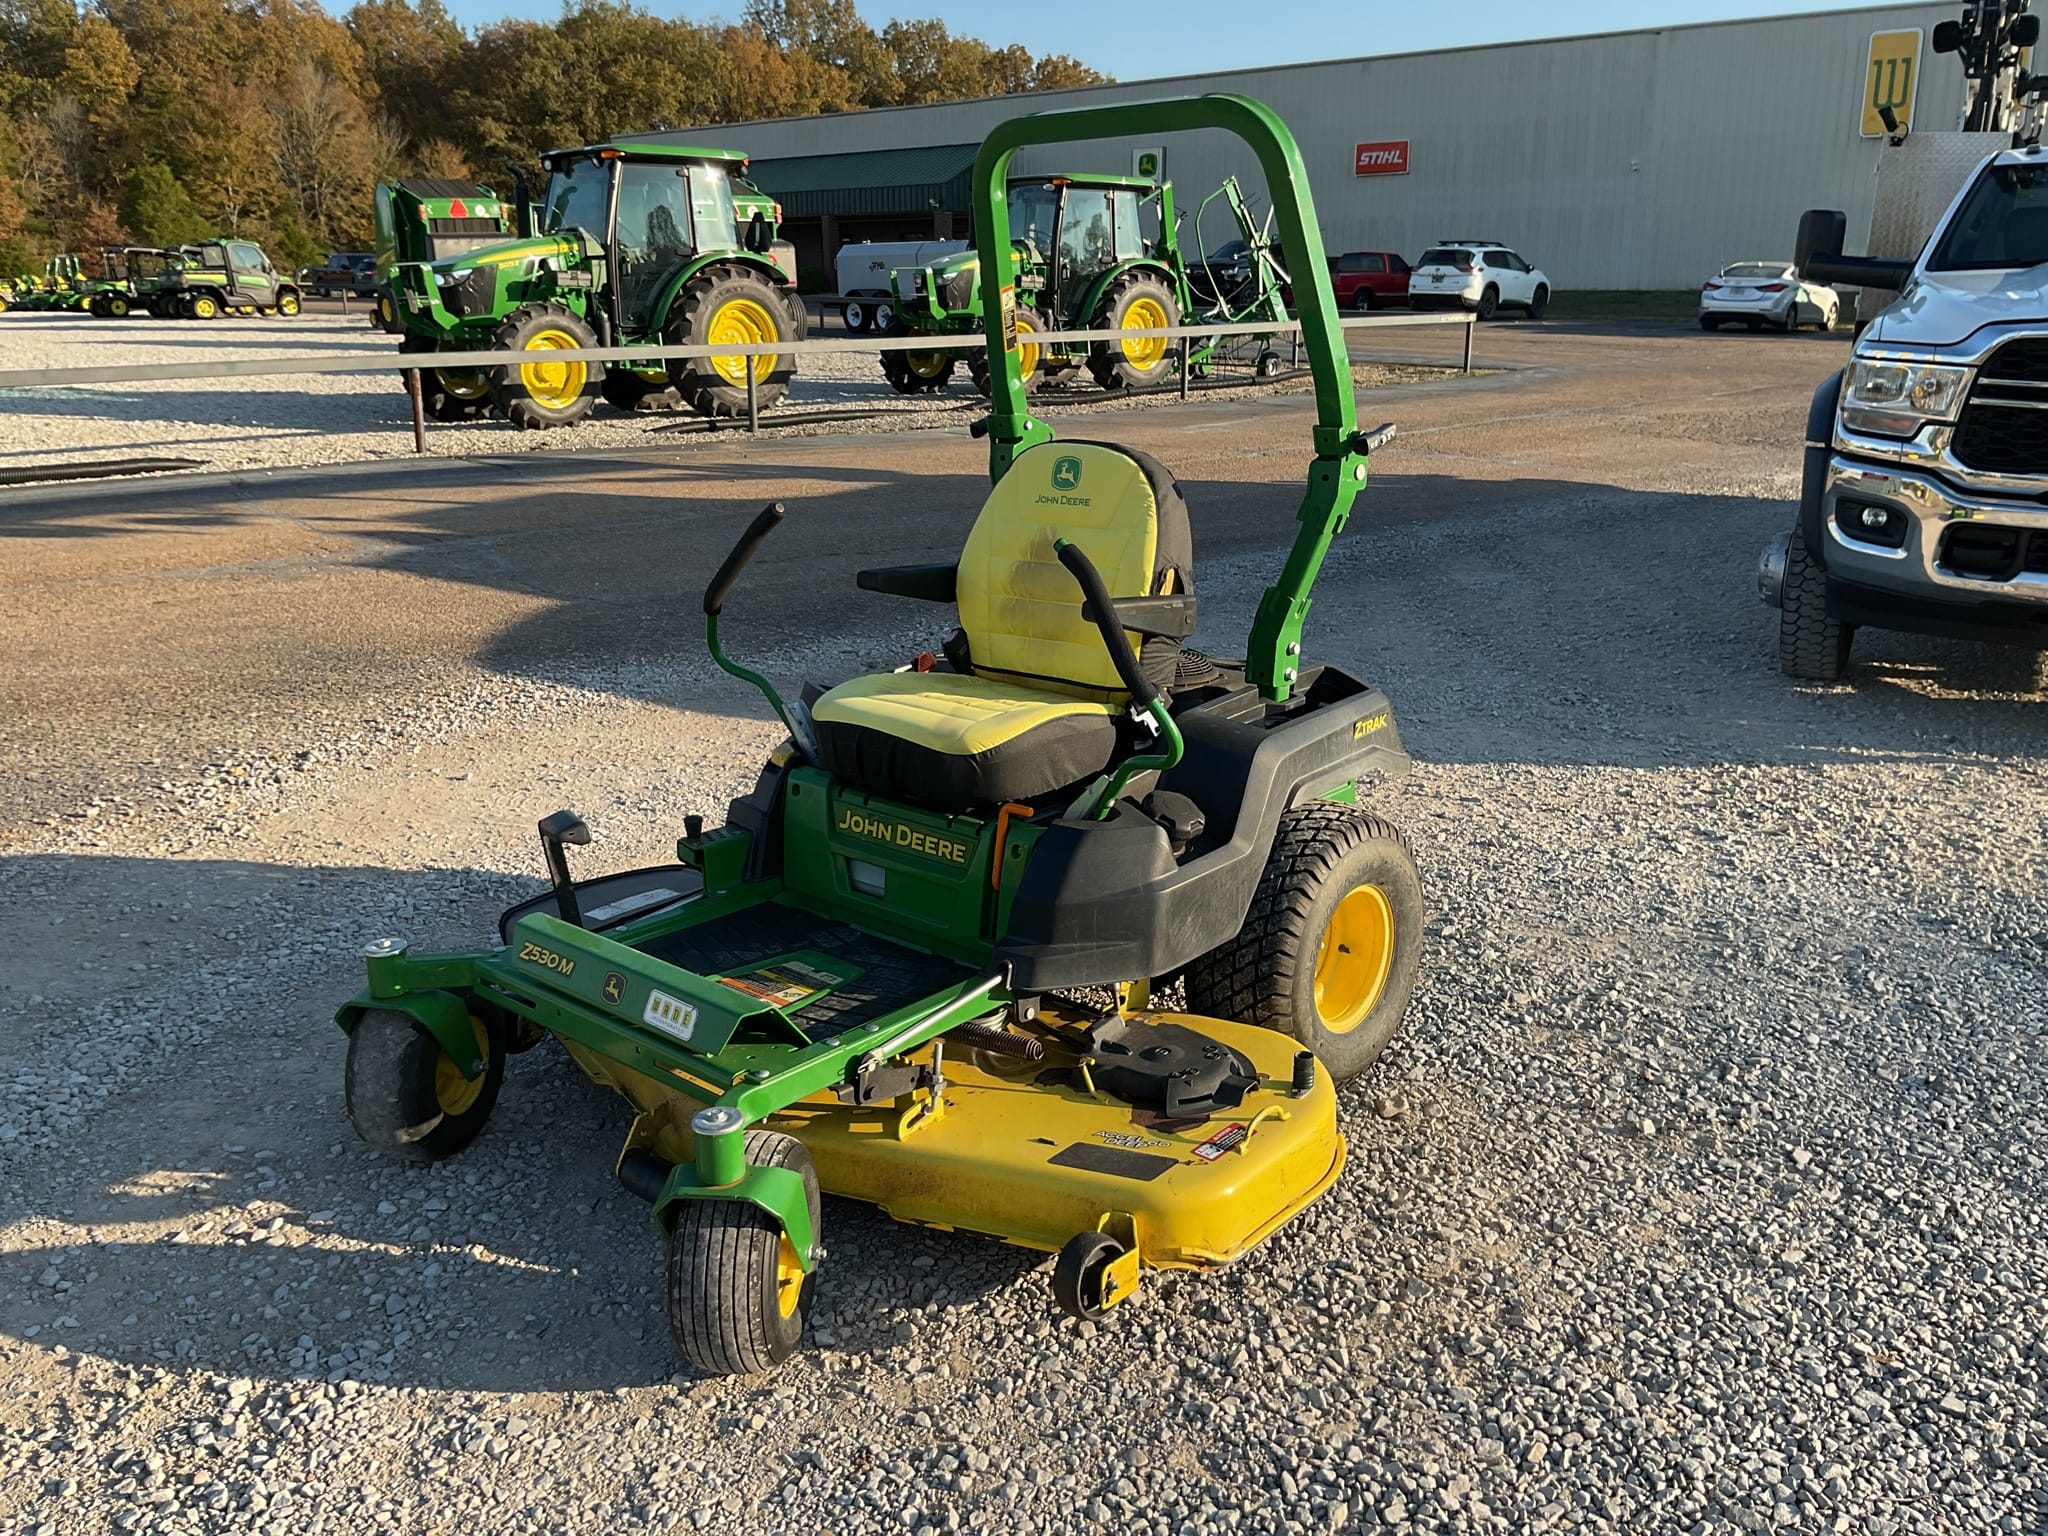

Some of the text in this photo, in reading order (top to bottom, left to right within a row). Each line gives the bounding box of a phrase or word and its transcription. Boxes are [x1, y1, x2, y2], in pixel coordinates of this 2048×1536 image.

[1358, 150, 1403, 166] STIHL
[1034, 493, 1092, 507] JOHN DEERE
[839, 809, 967, 864] JOHN DEERE
[1091, 1130, 1144, 1142] ACCEL
[1104, 1137, 1148, 1149] DEEP
